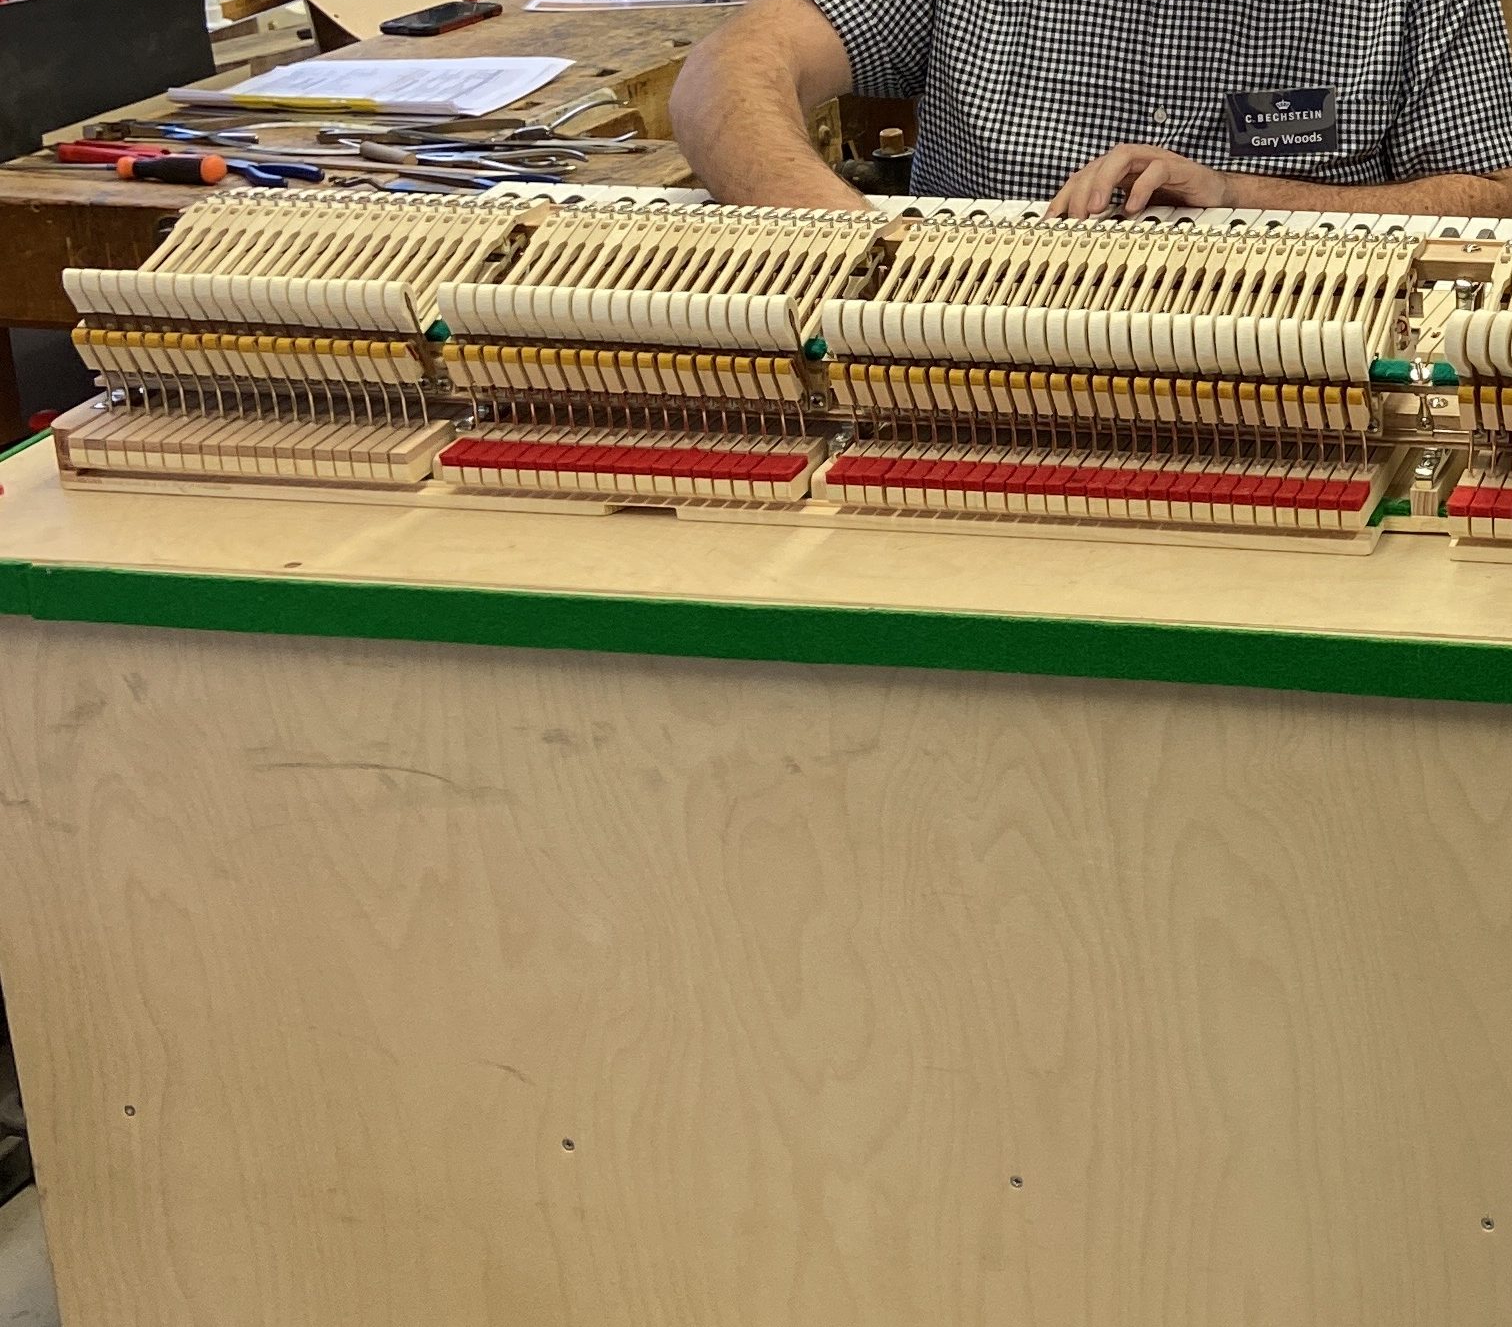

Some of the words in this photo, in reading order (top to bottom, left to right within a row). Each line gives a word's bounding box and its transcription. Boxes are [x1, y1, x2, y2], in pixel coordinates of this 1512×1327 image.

[1257, 110, 1322, 123] BECHSTEIN
[1251, 135, 1279, 148] Gary
[1282, 132, 1323, 145] Woods
